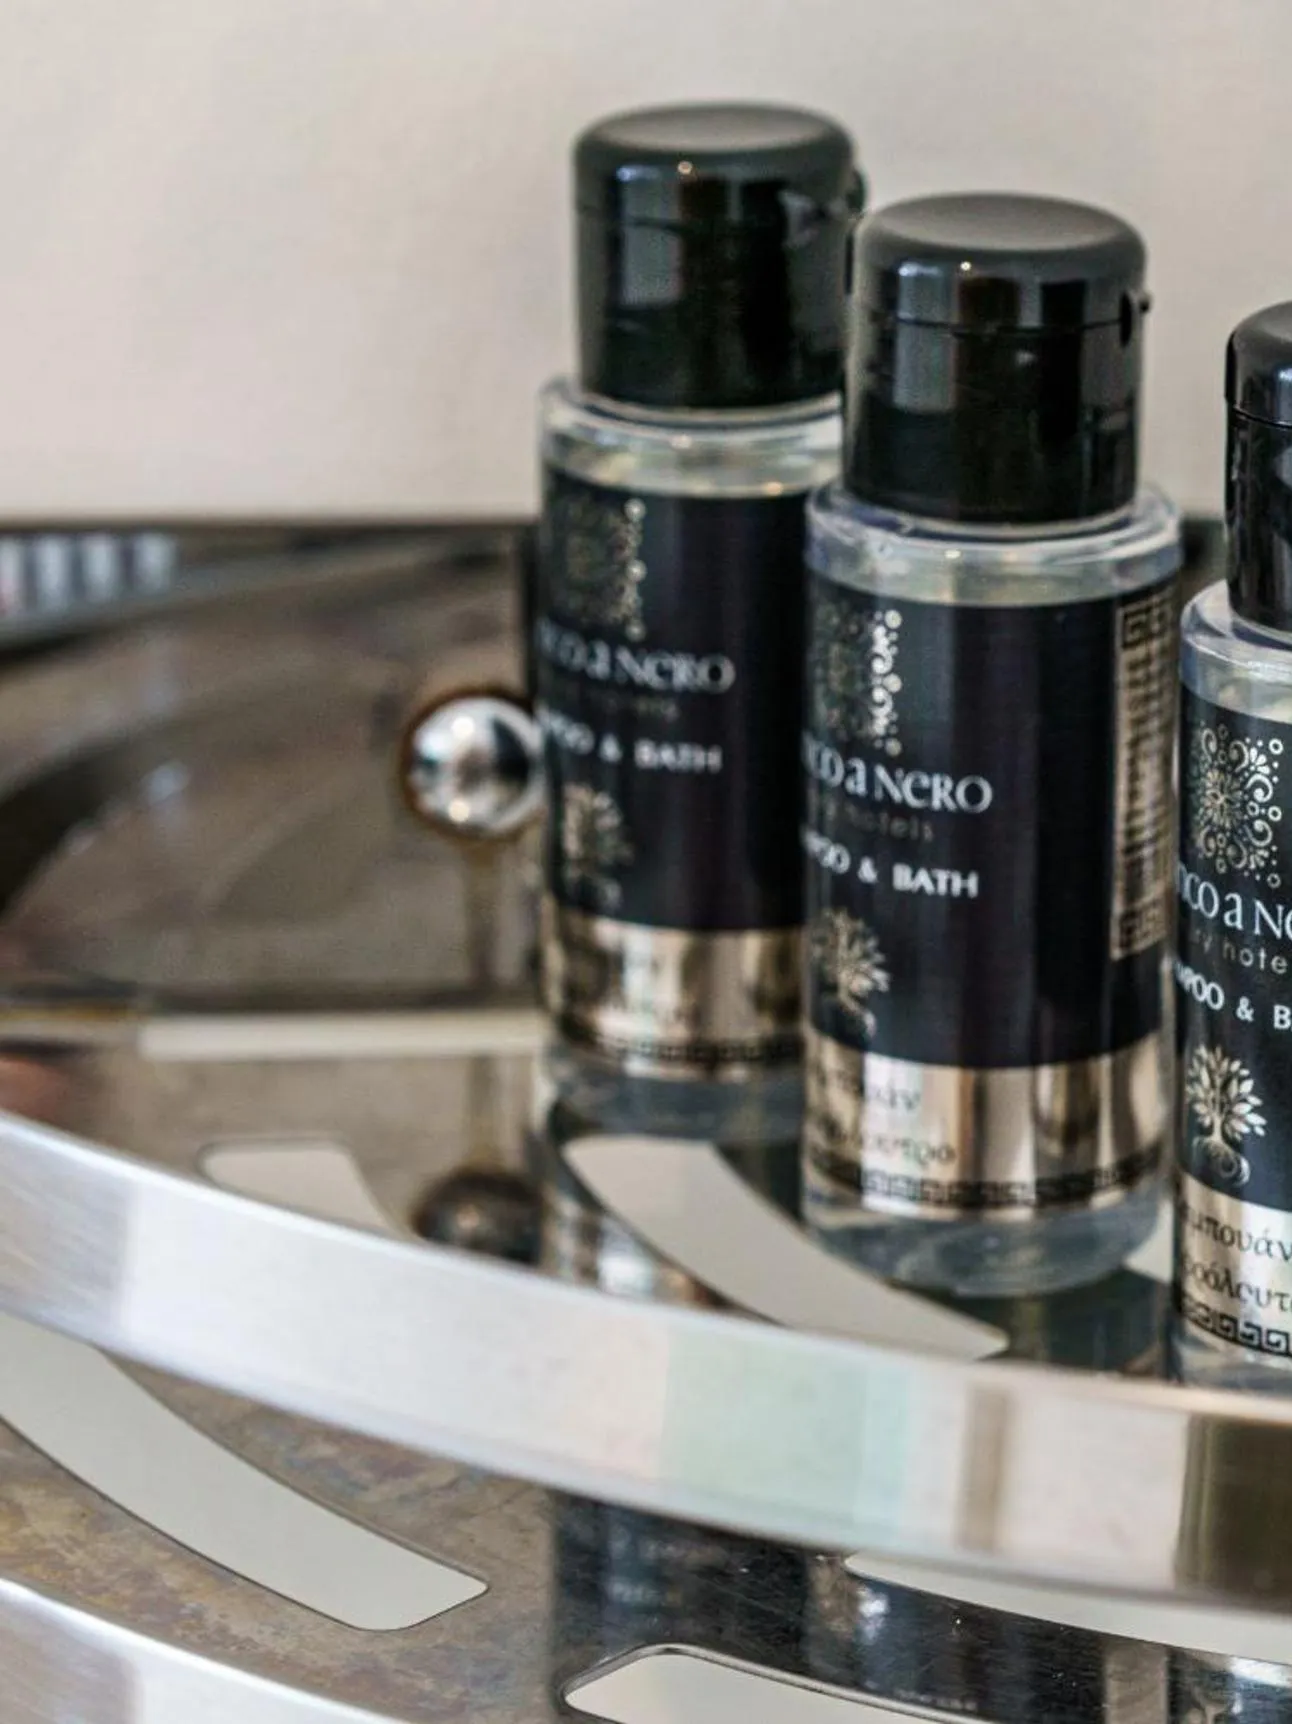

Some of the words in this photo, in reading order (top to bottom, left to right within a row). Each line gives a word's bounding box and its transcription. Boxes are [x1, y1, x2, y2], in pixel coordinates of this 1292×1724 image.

[892, 862, 979, 898] BATH
[1223, 891, 1244, 931] a
[1235, 996, 1255, 1022] &
